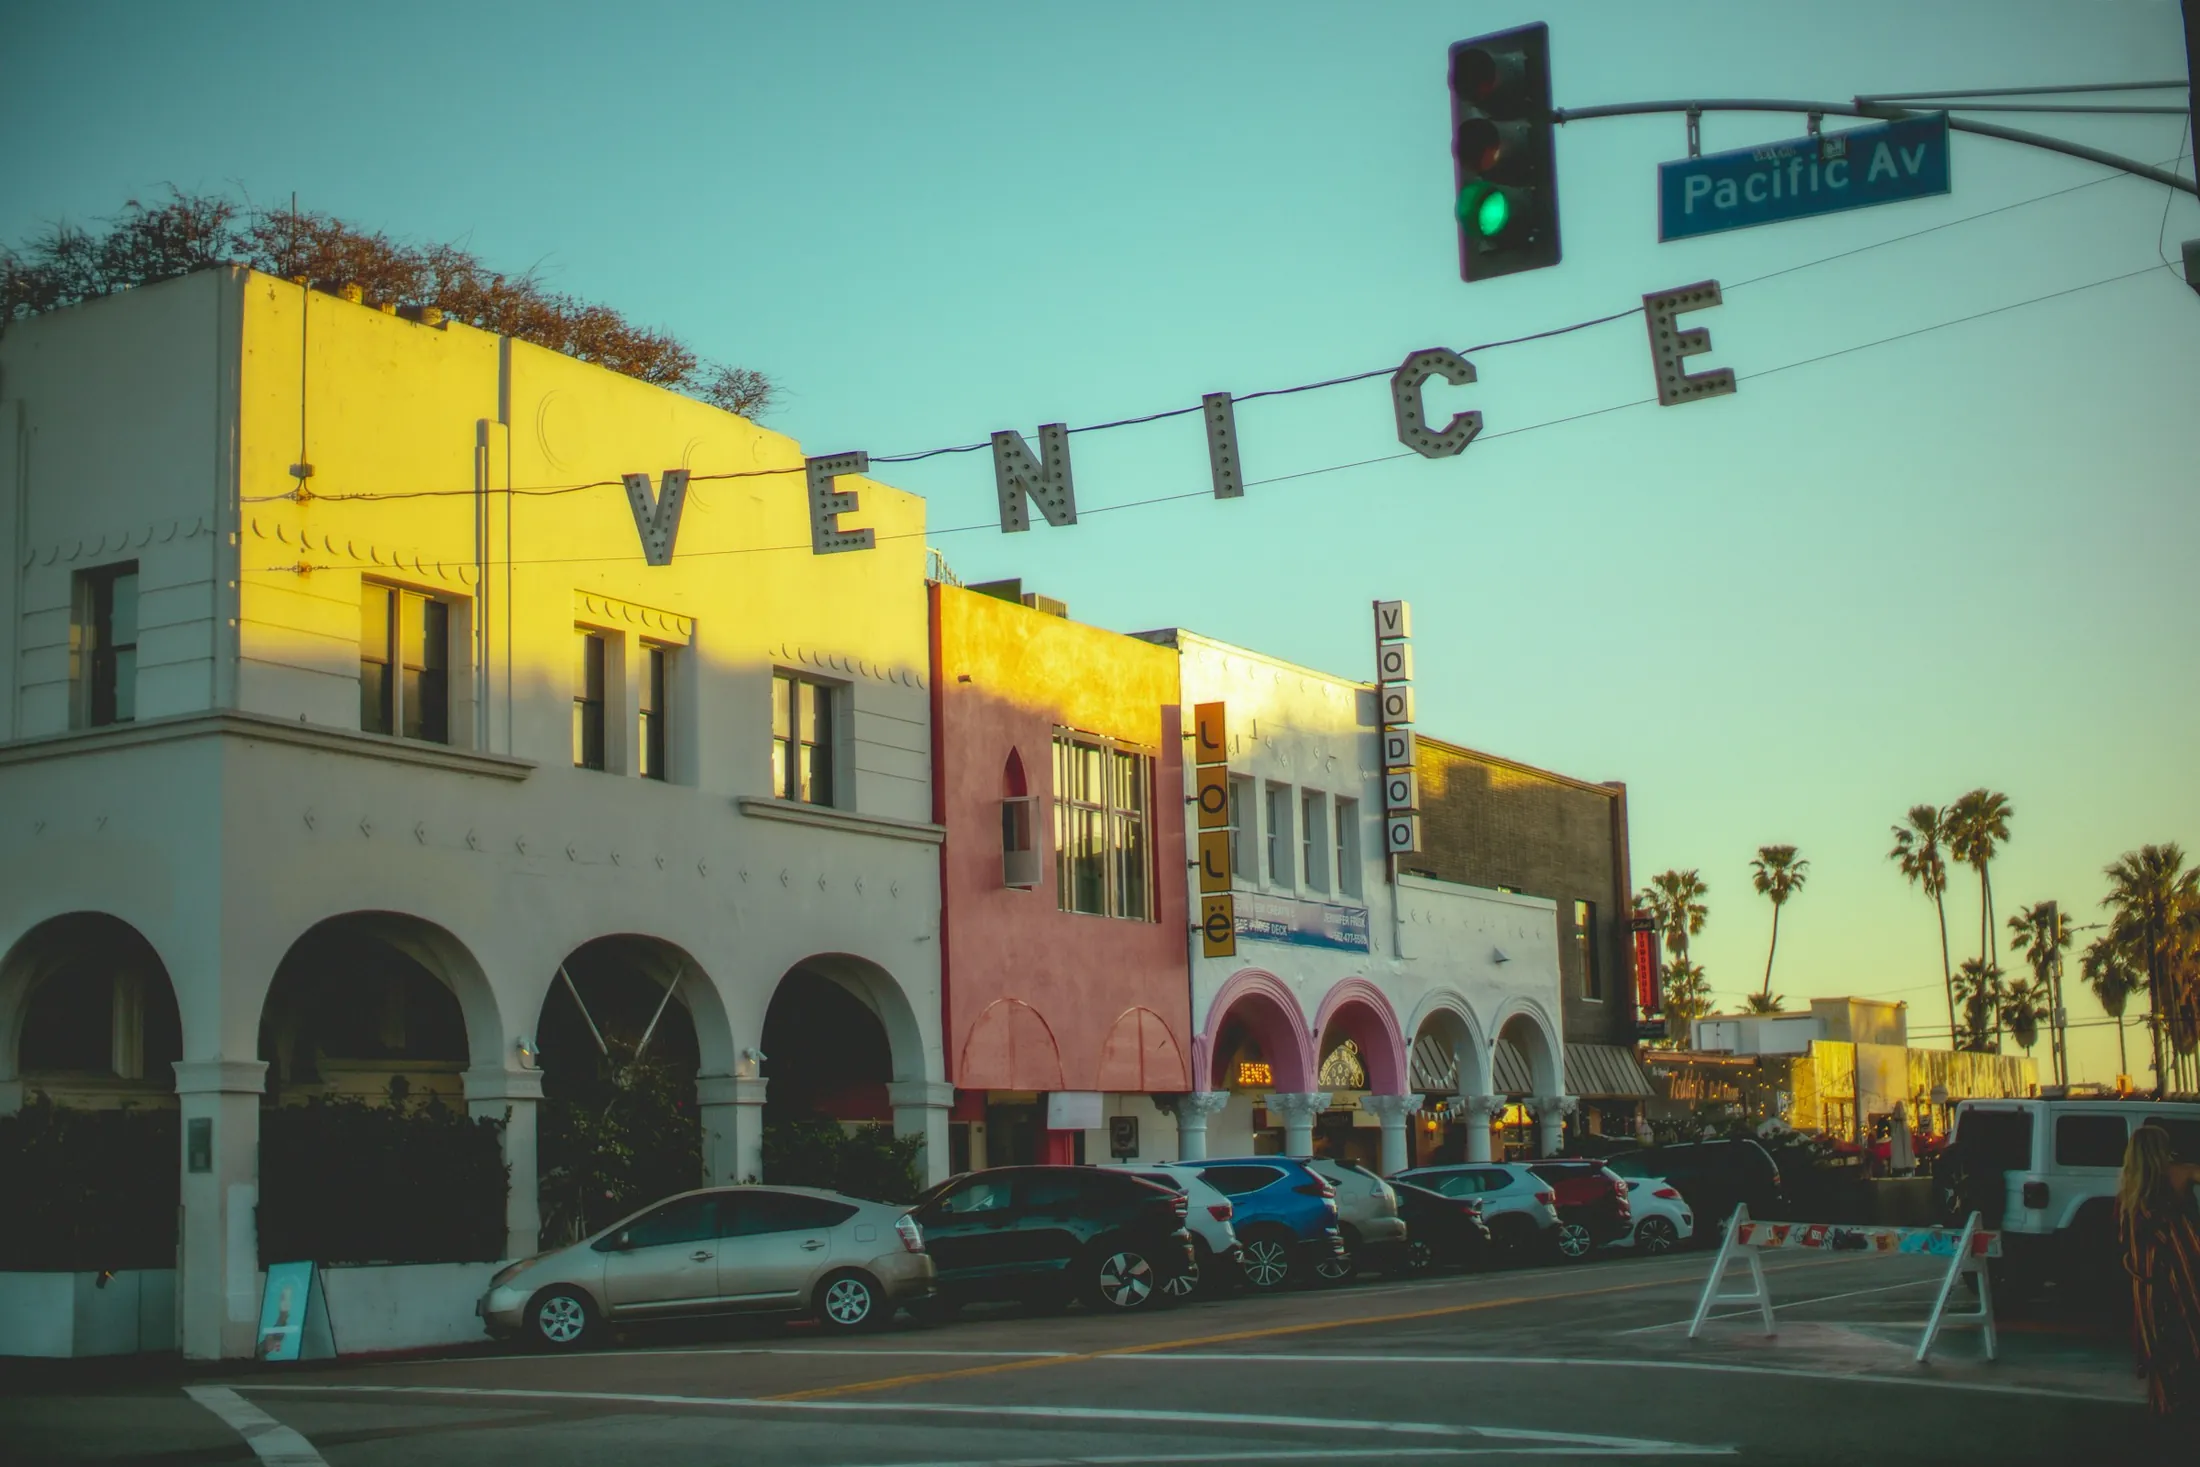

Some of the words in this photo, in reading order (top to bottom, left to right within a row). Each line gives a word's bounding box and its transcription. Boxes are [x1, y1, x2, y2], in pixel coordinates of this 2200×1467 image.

[1683, 152, 1849, 214] Pacific
[1867, 142, 1926, 182] Av
[622, 279, 1737, 566] VENICE
[1382, 608, 1411, 846] VOODOO
[1271, 923, 1288, 936] DECK
[1239, 1062, 1271, 1083] JENI'S
[1670, 1069, 1705, 1111] Teddy's
